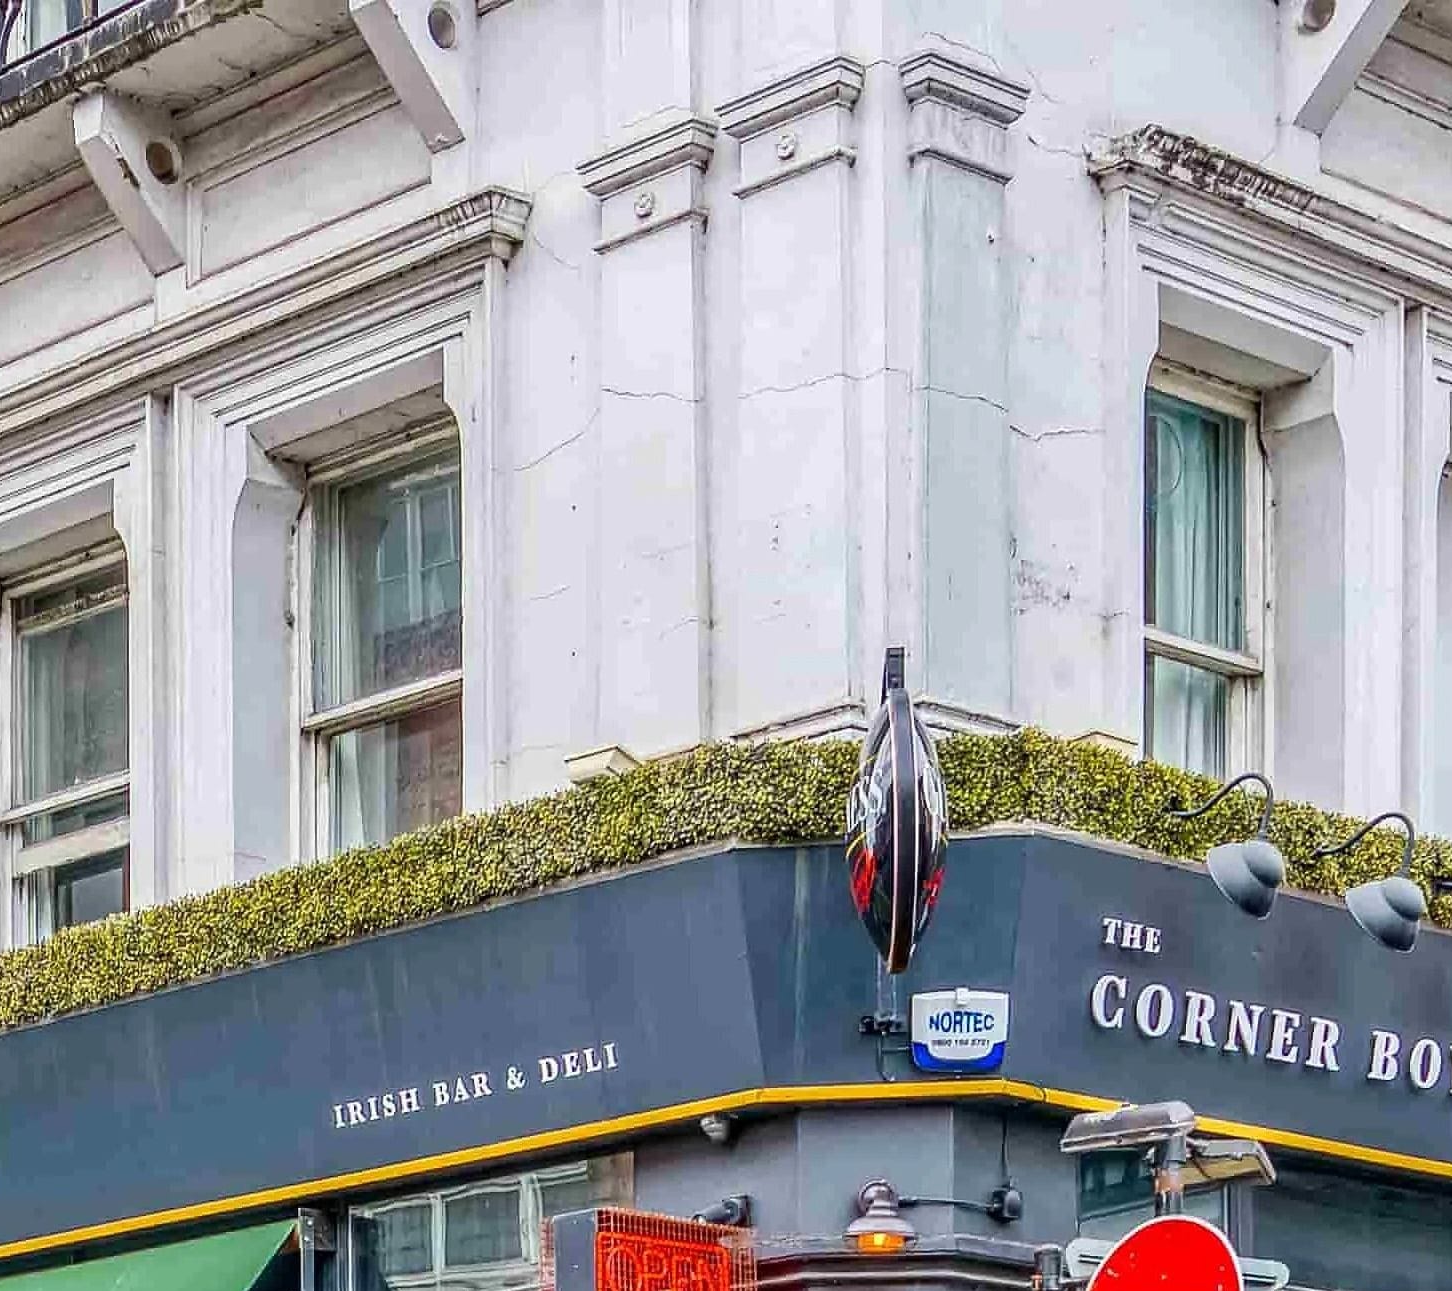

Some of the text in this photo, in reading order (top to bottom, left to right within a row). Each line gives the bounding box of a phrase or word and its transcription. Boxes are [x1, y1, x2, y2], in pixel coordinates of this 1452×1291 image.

[1103, 917, 1161, 954] THE
[929, 1011, 995, 1032] NORTEC
[1090, 973, 1341, 1072] CORNER
[333, 1042, 619, 1128] IRISH BAR & DELI
